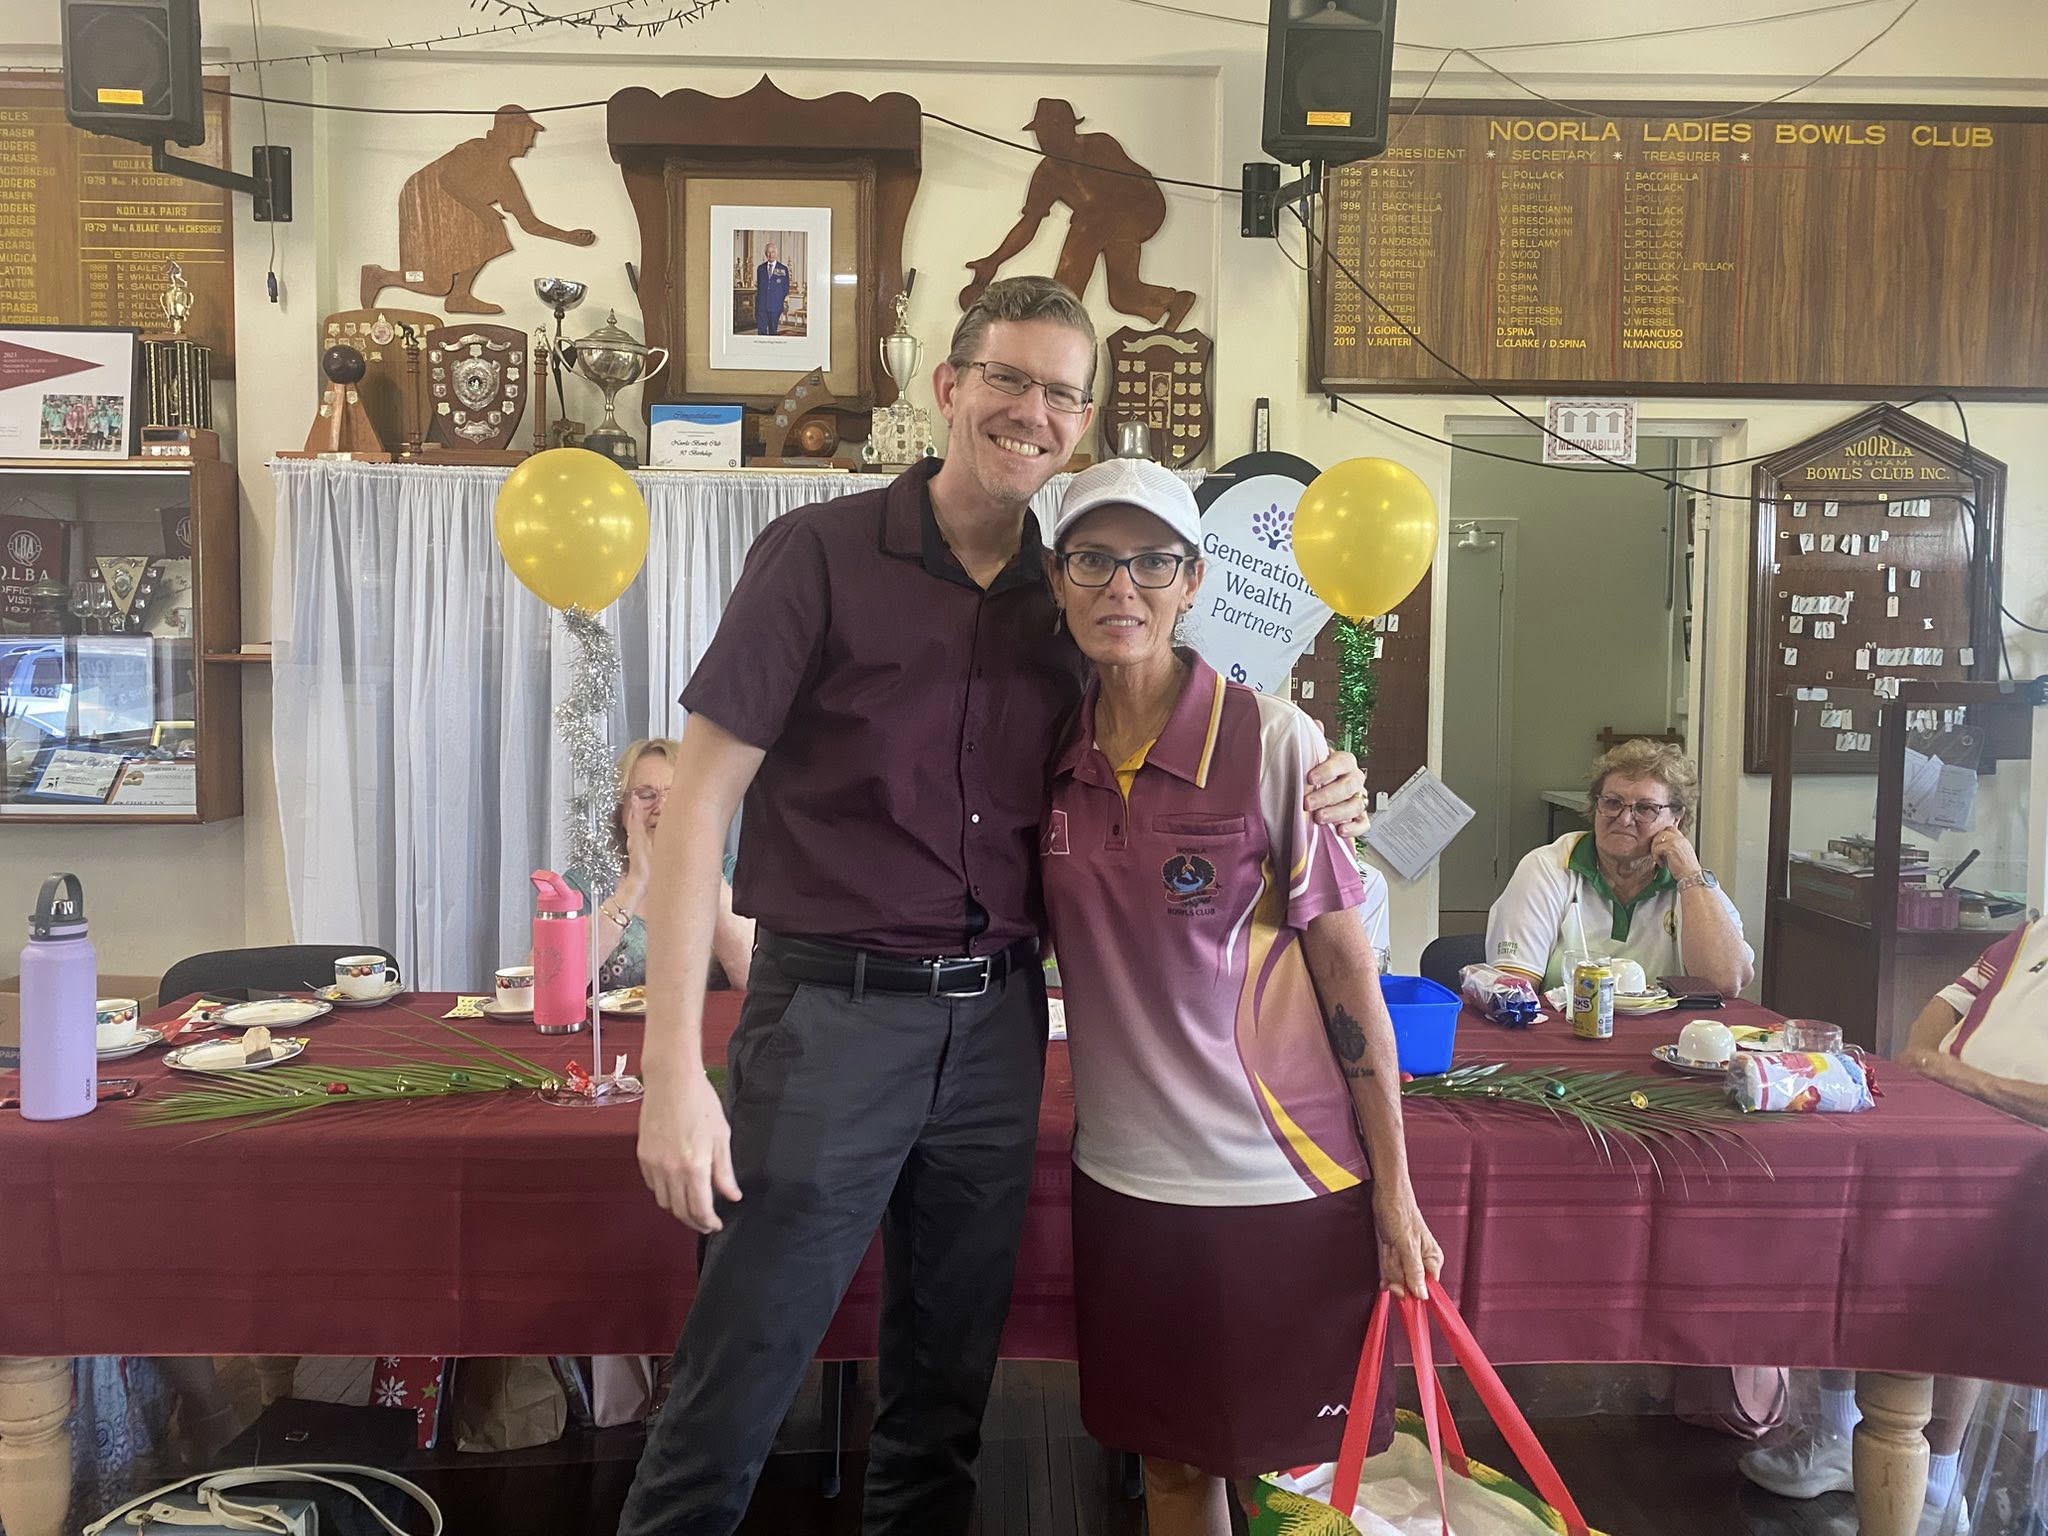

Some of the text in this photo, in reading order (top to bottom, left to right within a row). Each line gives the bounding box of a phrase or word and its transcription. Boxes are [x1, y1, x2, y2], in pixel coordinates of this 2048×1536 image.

[1490, 120, 1994, 147] NOORLA LADIES BOWLS CLUB
[1387, 148, 1465, 159] PRESIDENT
[1512, 150, 1596, 160] SECRETARY
[1642, 151, 1720, 161] TREASURER
[1382, 169, 1415, 177] KELLY
[1382, 180, 1415, 188] KELLY
[1340, 202, 1361, 210] 1998
[160, 207, 187, 216] PAIRS
[84, 223, 106, 232] 1979
[1380, 238, 1431, 246] ANDERSON
[1512, 240, 1560, 248] BELLAMY
[1511, 250, 1540, 259] WOOD
[1380, 260, 1426, 268] GIORCELLI
[1511, 261, 1538, 270] SPINA
[1380, 271, 1415, 279] RAITERI
[1511, 272, 1538, 281] SPINA
[1380, 282, 1415, 290] RAITERI
[1510, 284, 1538, 292] SPINA
[1510, 295, 1539, 303] SPINA
[1334, 304, 1360, 312] 2007
[1334, 326, 1356, 334] 2009
[1333, 338, 1356, 346] 2010
[1845, 435, 1914, 457] NOORLA
[1806, 468, 1950, 480] BOWLS CLUB INC.
[1226, 571, 1293, 615] Wealth
[1210, 597, 1293, 644] Partners
